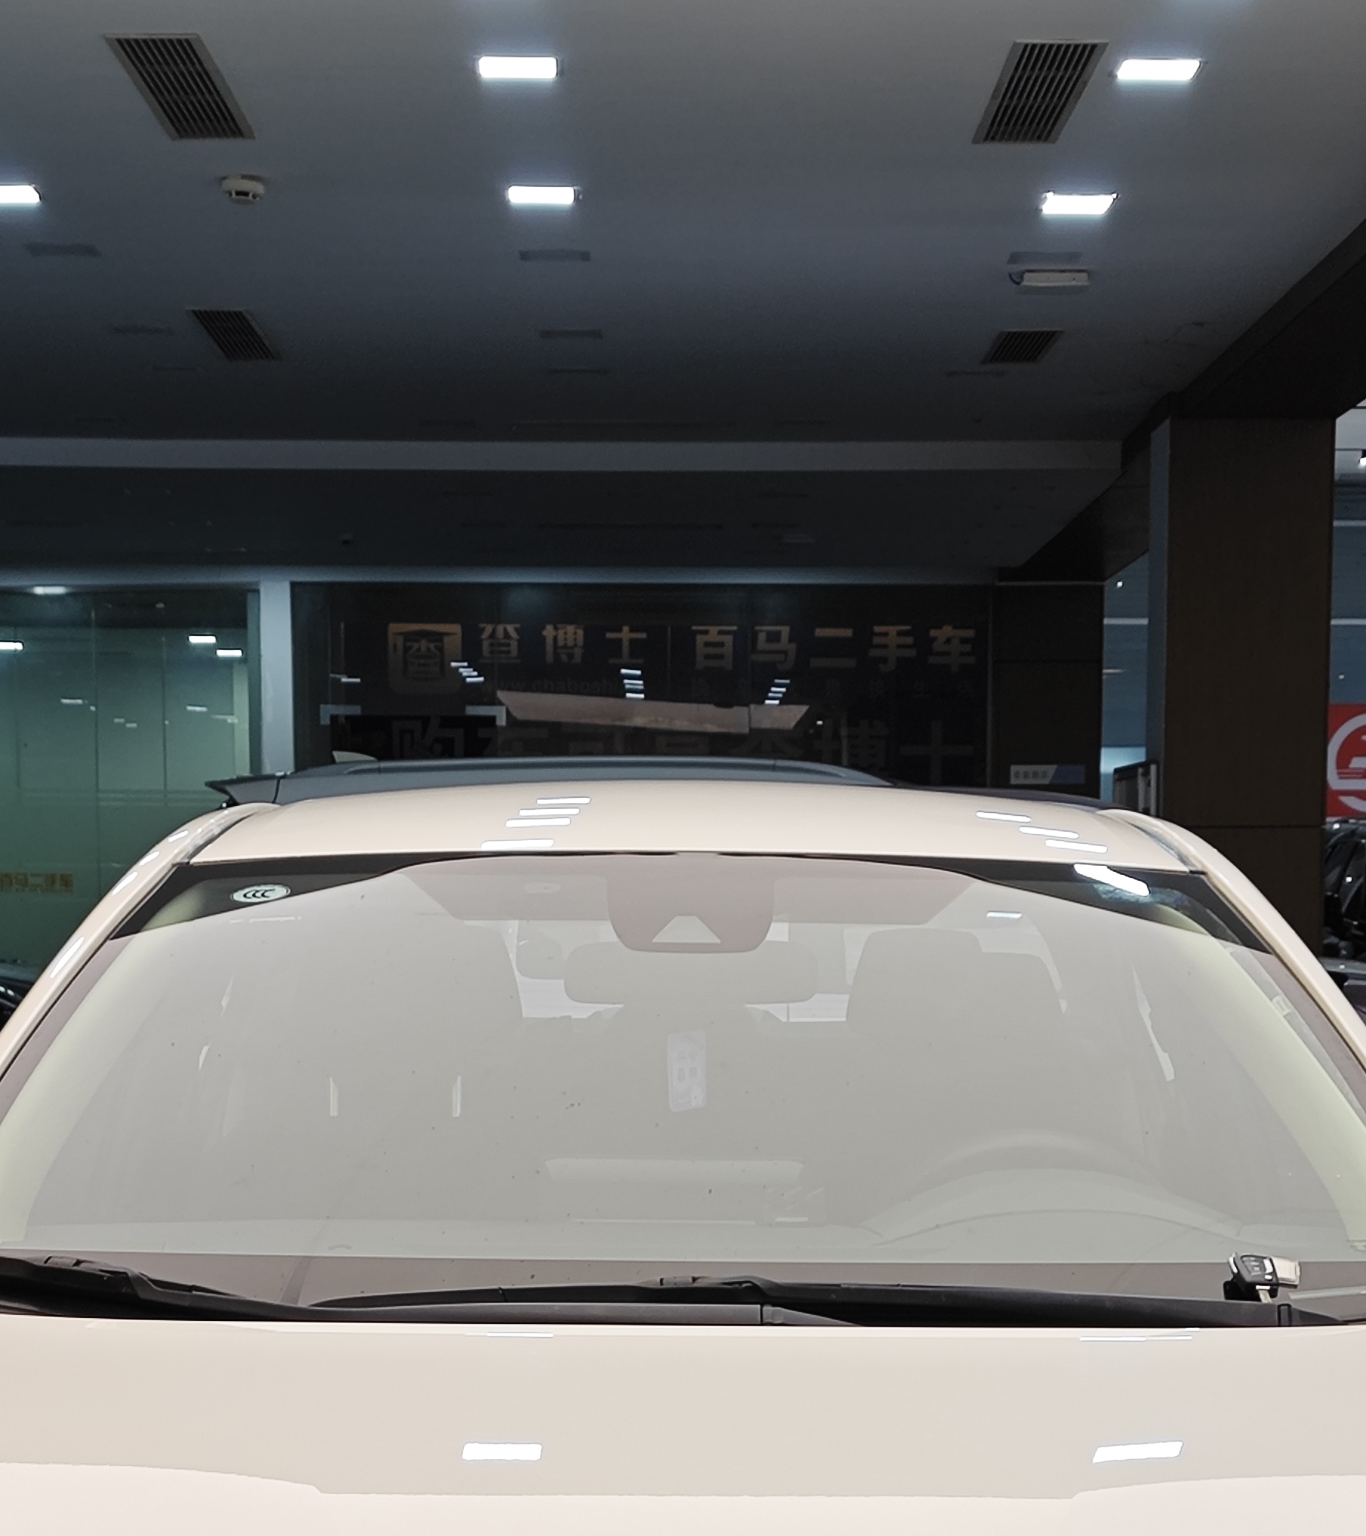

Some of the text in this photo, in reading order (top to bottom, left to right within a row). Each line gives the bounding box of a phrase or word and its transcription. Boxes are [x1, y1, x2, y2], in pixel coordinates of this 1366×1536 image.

[691, 624, 977, 672] 百马二手车
